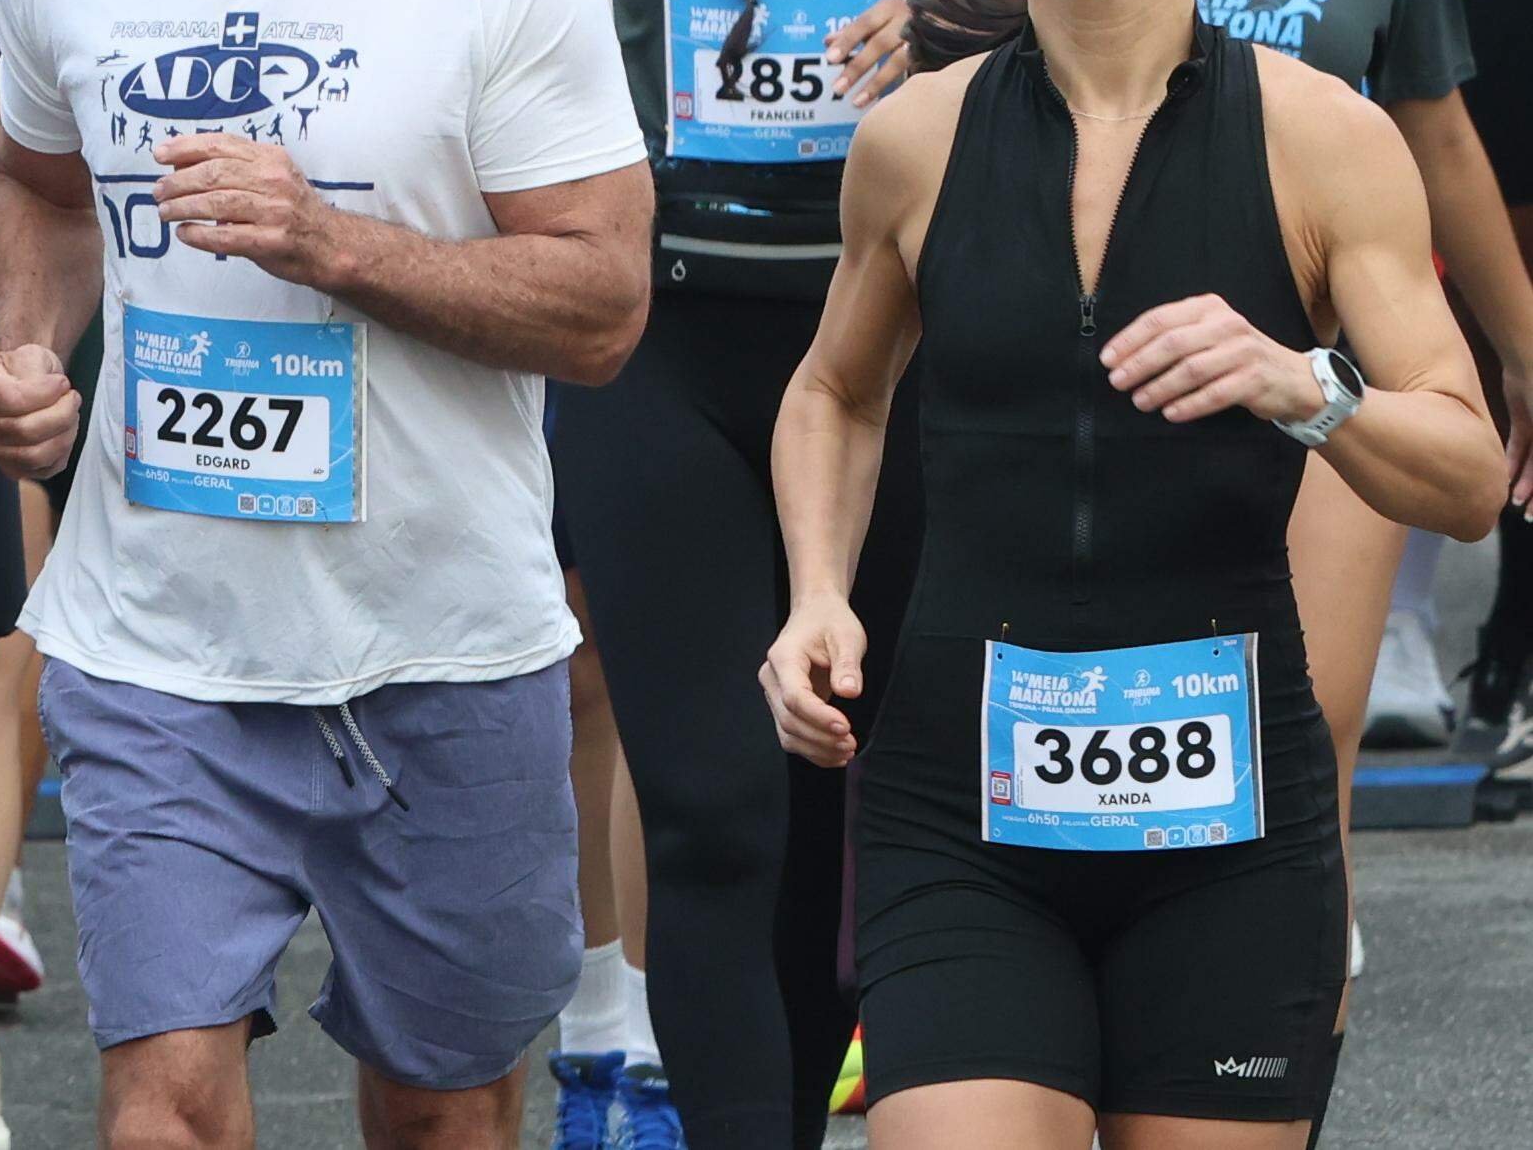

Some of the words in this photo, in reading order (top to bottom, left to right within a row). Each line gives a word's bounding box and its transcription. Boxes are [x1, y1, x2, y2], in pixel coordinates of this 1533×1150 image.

[110, 21, 220, 40] PROGRAMA
[261, 21, 343, 41] ATLETA
[750, 109, 815, 122] FRANCIELE
[147, 333, 180, 350] MEIA
[135, 345, 202, 369] MARATONA
[270, 353, 344, 377] 10km
[156, 387, 304, 452] 2267
[196, 453, 251, 471] EDGARD
[194, 475, 234, 491] GERAL
[1027, 673, 1071, 691] MEIA
[1171, 672, 1240, 699] 10km
[1009, 688, 1098, 707] MARATONA
[1034, 720, 1217, 786] 3688
[1097, 792, 1152, 806] XANDA
[1027, 813, 1060, 827] 6h50
[1090, 814, 1139, 828] GERAL
